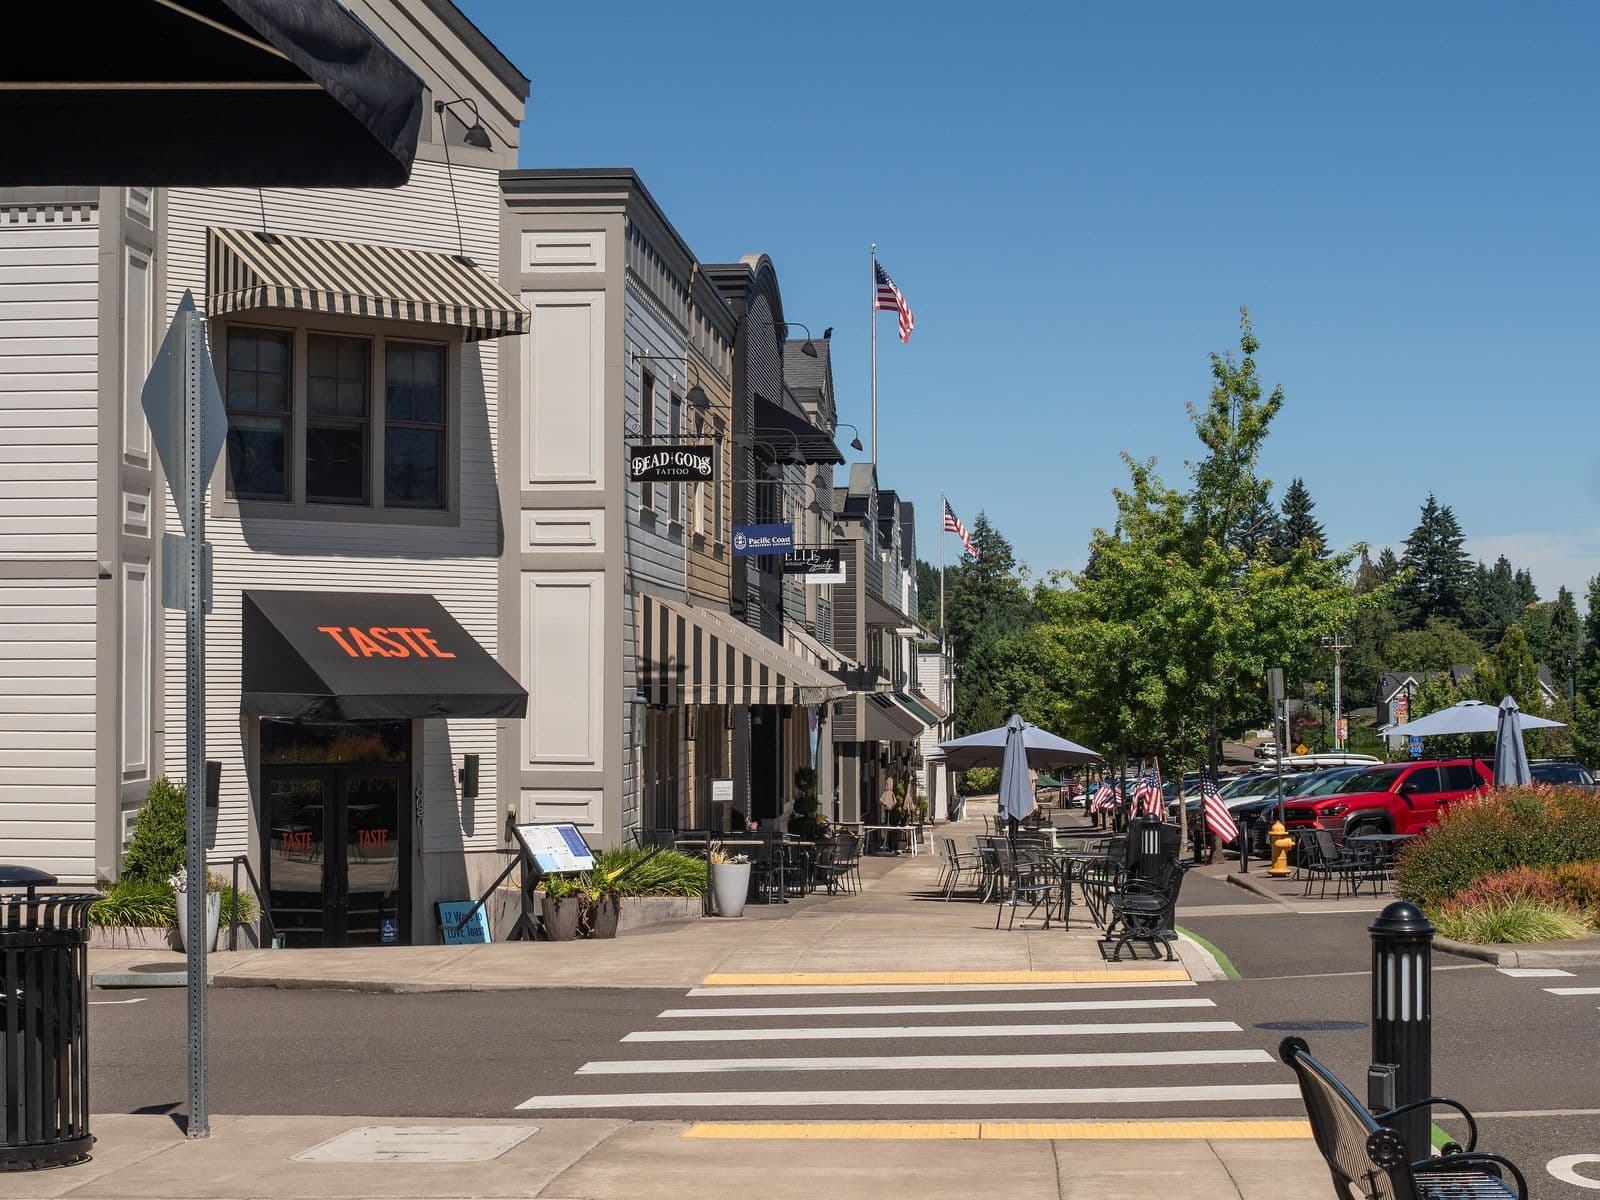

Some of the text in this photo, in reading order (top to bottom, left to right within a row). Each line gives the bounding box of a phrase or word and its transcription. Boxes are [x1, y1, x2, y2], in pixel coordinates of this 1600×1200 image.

[632, 452, 712, 475] DEAD GODS
[748, 536, 771, 545] Pacific
[771, 536, 791, 544] Coast
[785, 549, 819, 561] ELLE
[317, 626, 457, 658] TASTE
[281, 832, 313, 849] TASTE
[358, 829, 389, 848] TASTE
[444, 911, 453, 924] 12
